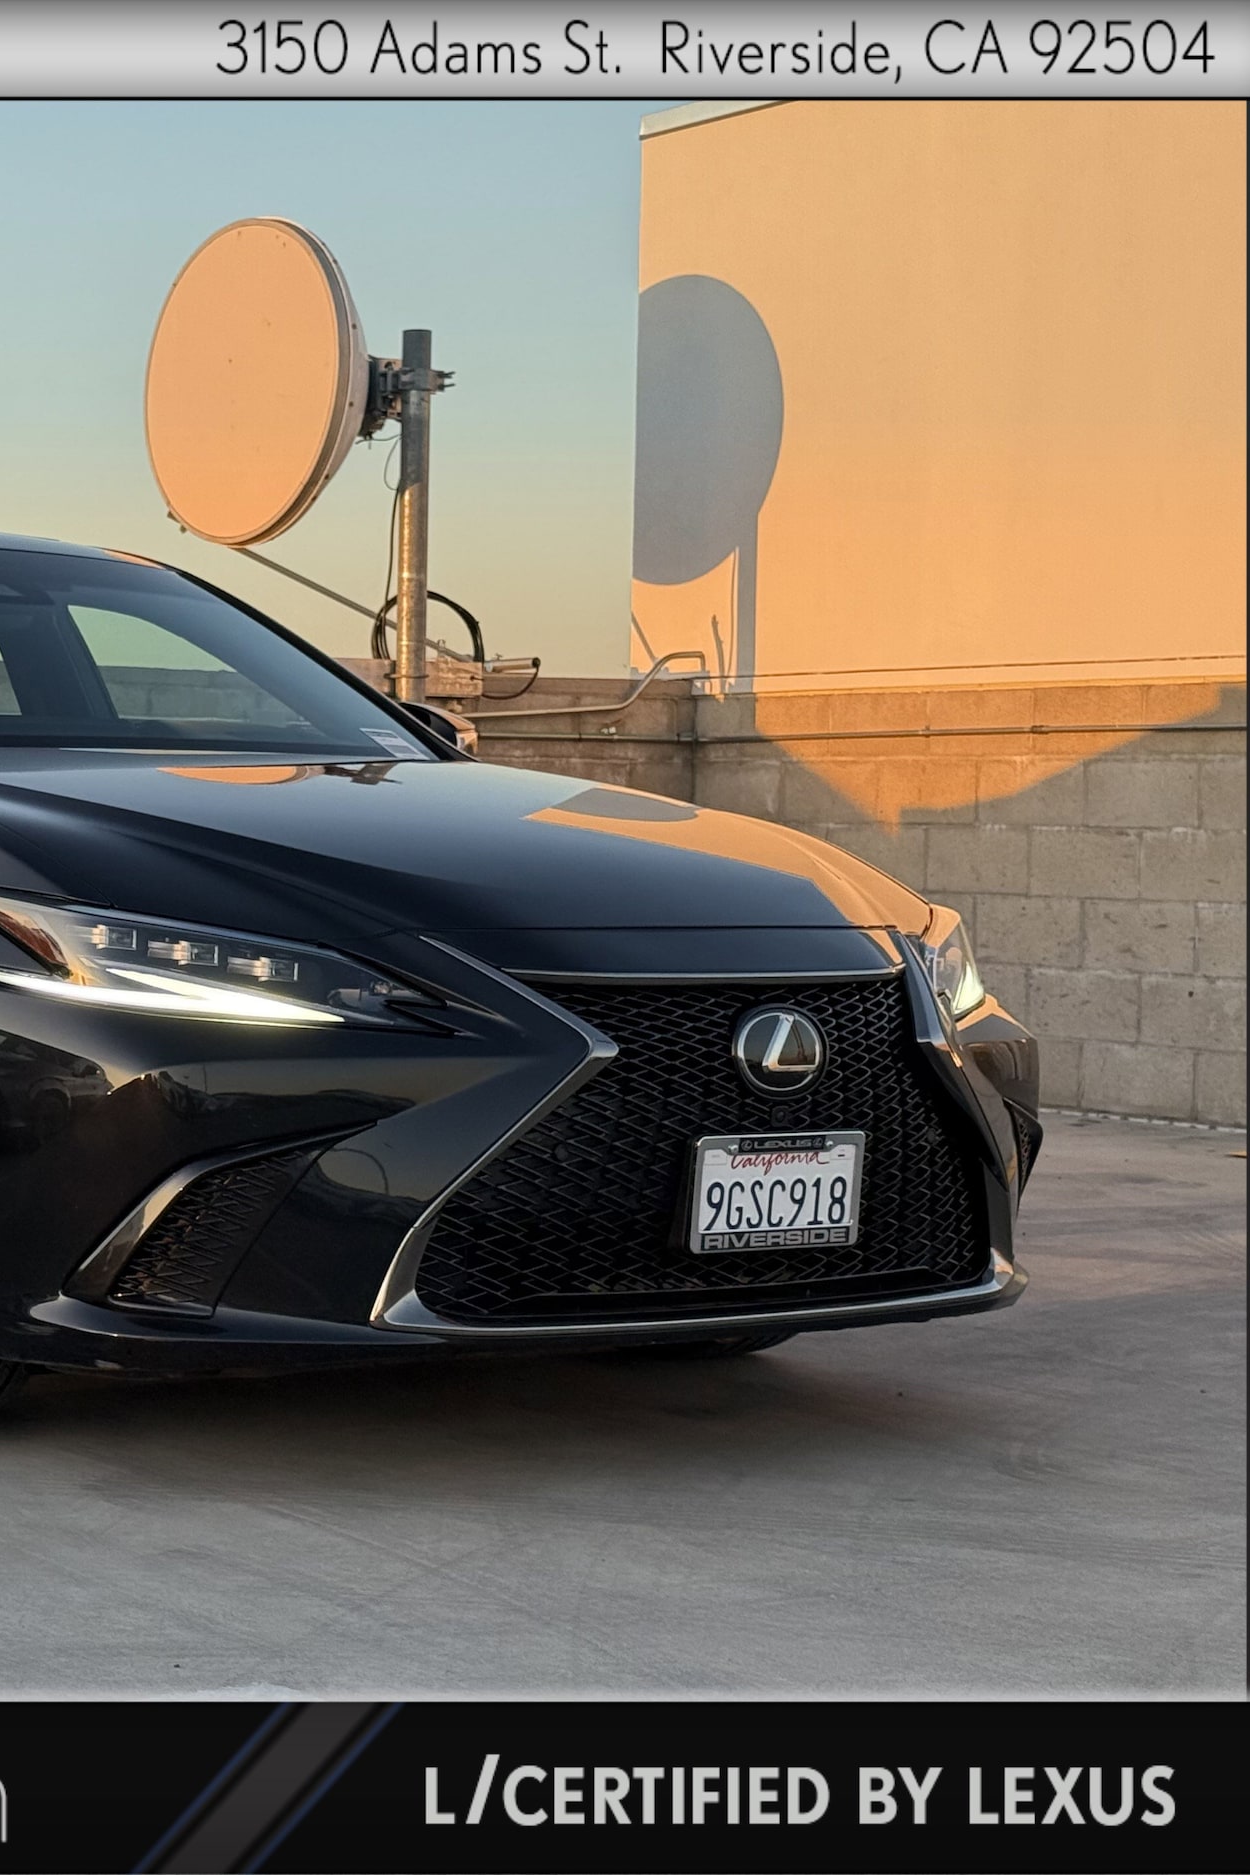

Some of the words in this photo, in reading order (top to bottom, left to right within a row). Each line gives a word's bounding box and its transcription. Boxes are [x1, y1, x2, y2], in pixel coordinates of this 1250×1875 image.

[754, 1139, 812, 1149] LEXUS
[730, 1152, 830, 1176] California
[703, 1176, 847, 1231] 9GSC918
[704, 1228, 847, 1250] RIVERSIDE
